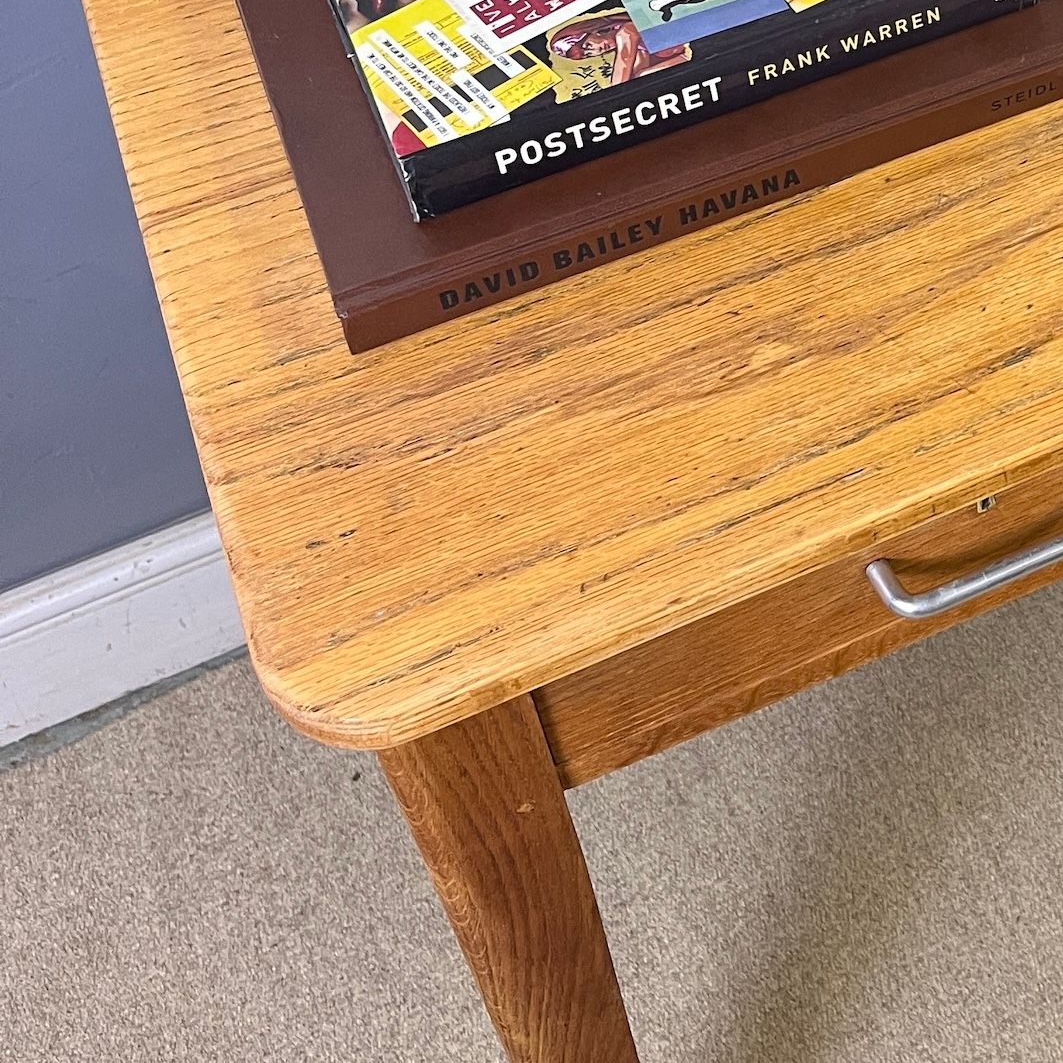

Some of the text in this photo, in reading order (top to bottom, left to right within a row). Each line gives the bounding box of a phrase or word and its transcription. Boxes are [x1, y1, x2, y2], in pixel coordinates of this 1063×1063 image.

[494, 75, 722, 175] POSTSECRET
[746, 47, 832, 86] FRANK
[839, 7, 942, 52] WARREN
[439, 81, 1057, 311] DAVID BAILEY HAVANA STEIDL
